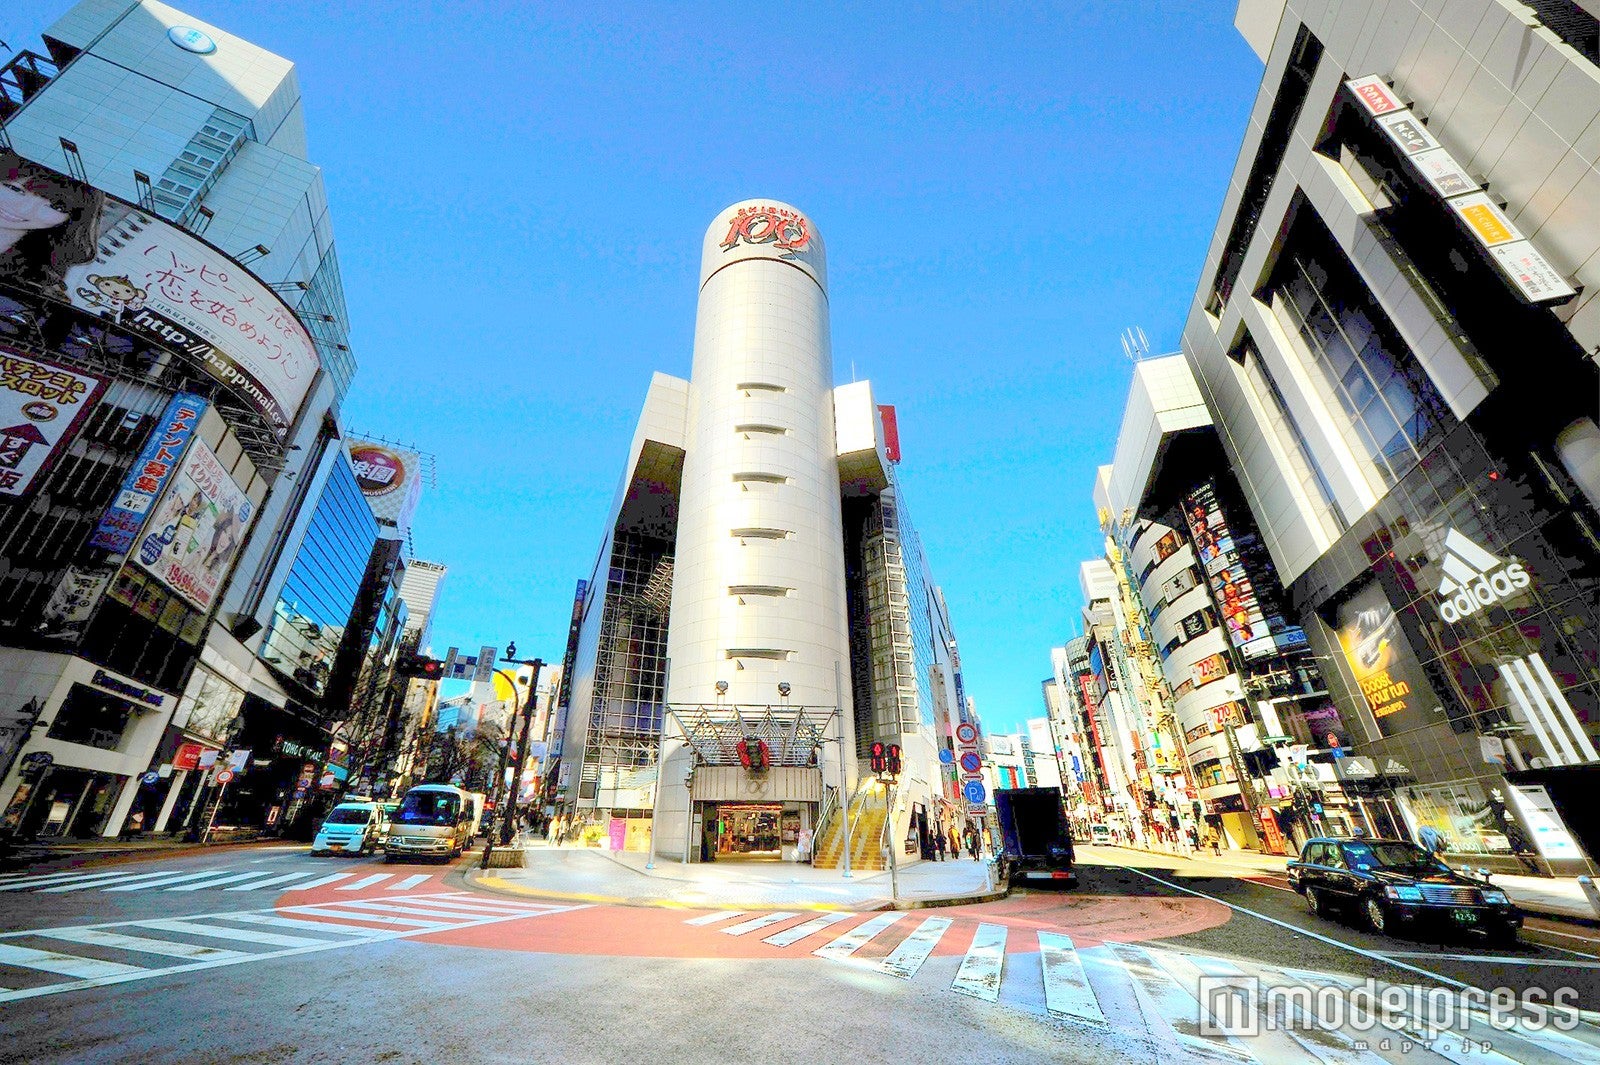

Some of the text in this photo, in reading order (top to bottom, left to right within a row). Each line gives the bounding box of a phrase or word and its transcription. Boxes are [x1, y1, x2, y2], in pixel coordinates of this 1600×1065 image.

[719, 212, 811, 250] 109
[134, 309, 288, 437] http://happymail.cojp
[1440, 563, 1530, 624] adidas
[1198, 657, 1215, 677] 270
[1362, 671, 1393, 695] boost
[1367, 687, 1391, 710] your
[1388, 680, 1410, 699] run
[1213, 704, 1231, 724] 270
[960, 728, 973, 739] 30
